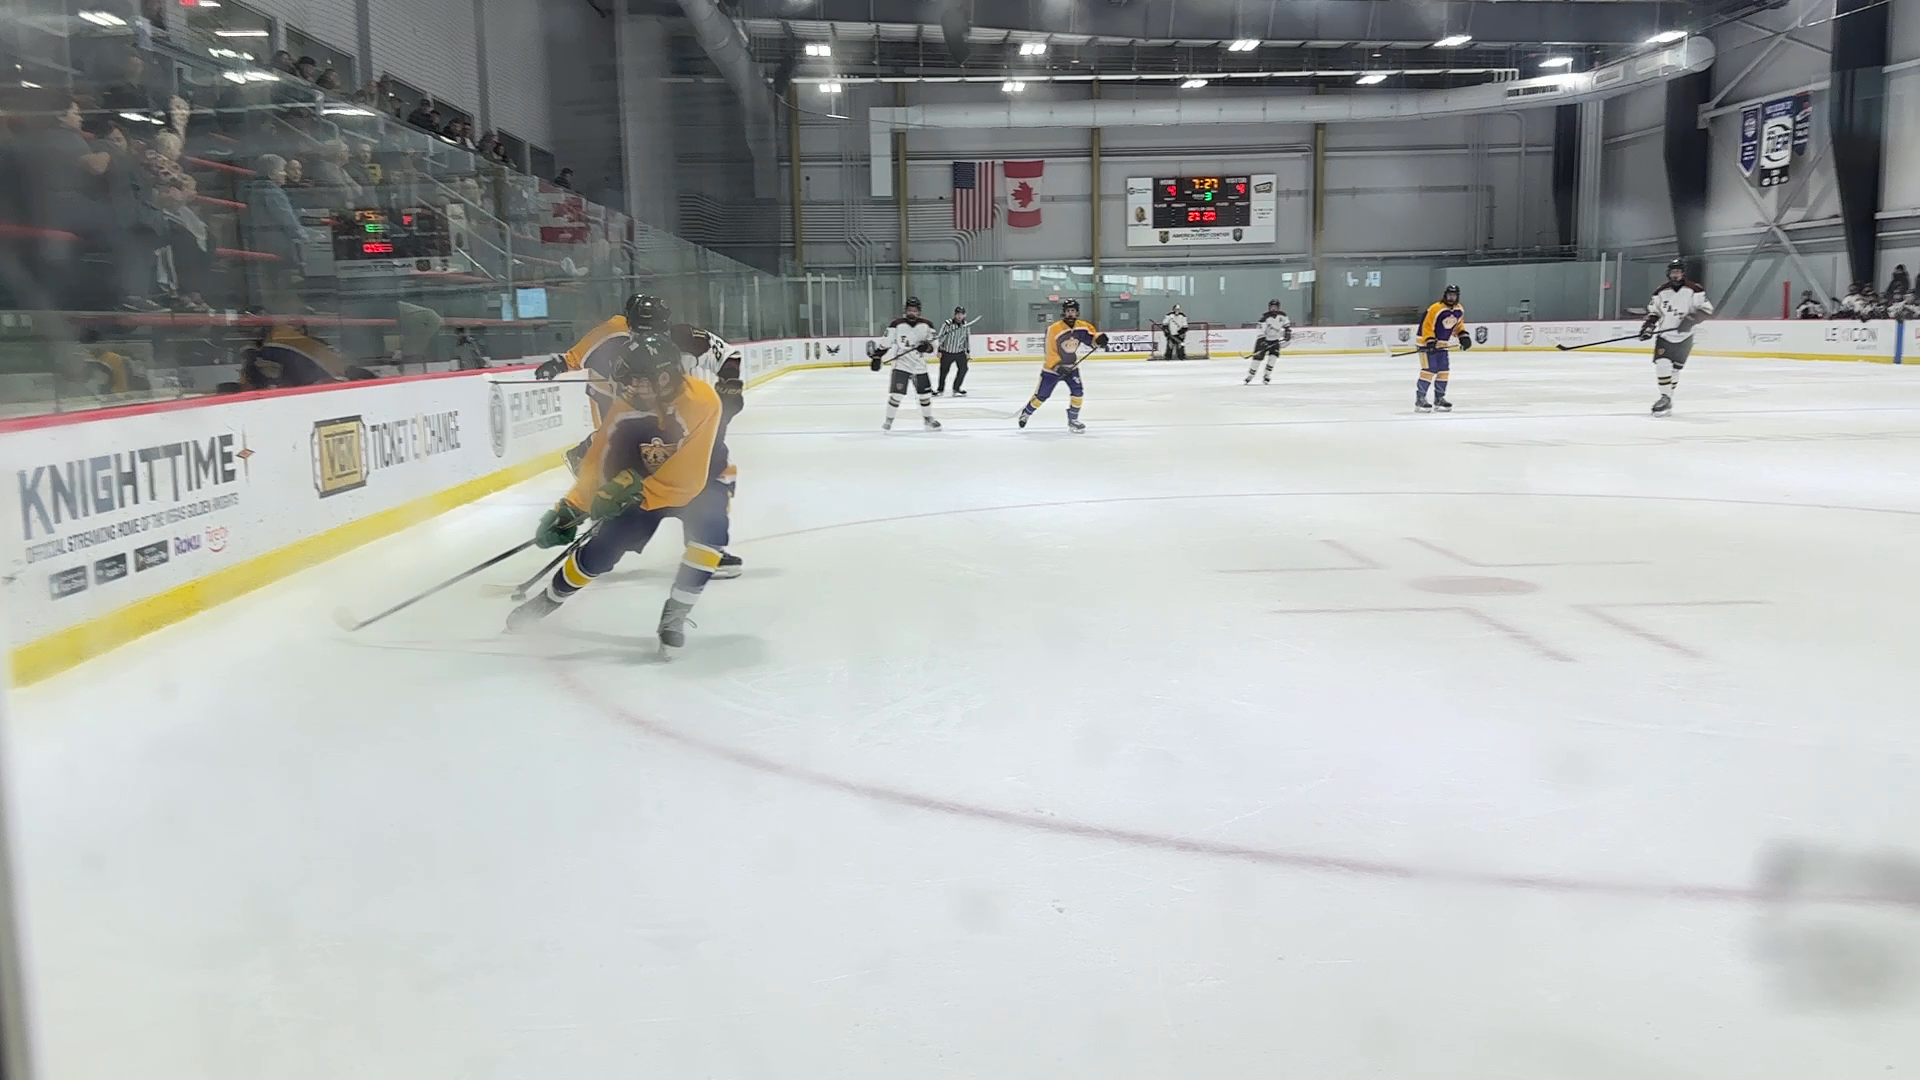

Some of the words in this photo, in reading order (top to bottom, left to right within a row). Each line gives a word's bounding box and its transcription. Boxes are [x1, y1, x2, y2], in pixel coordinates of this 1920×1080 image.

[1192, 178, 1218, 189] 7:27
[1204, 191, 1213, 201] 3
[986, 337, 1019, 352] tsk
[1107, 343, 1130, 352] YOU
